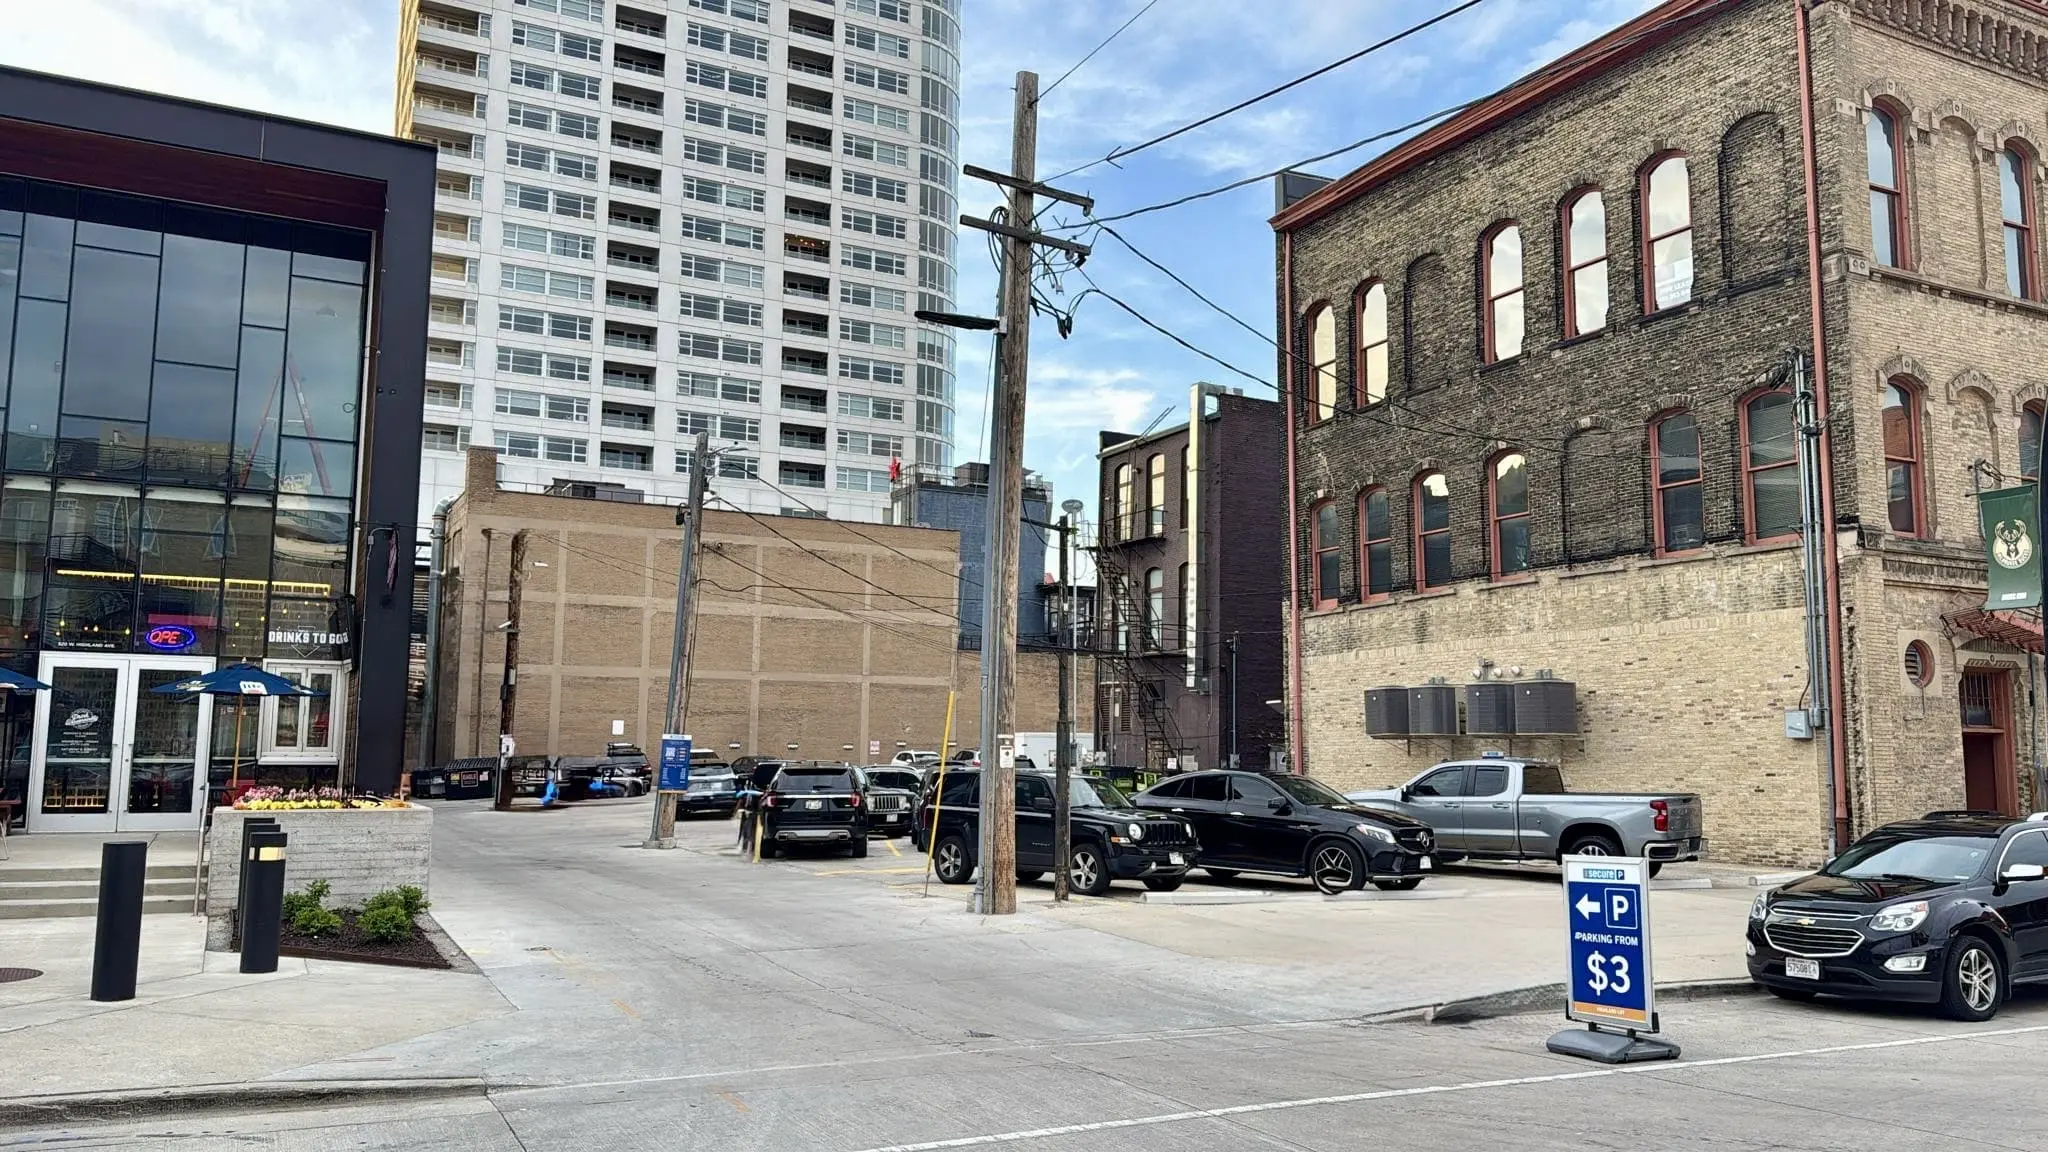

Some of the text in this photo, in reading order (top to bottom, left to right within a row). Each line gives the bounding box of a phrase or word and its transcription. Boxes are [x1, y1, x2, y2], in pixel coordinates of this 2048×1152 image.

[268, 631, 309, 643] DRINKS
[312, 633, 326, 644] TO
[1612, 896, 1628, 921] P
[1614, 935, 1638, 946] FROM
[1587, 950, 1630, 996] $3
